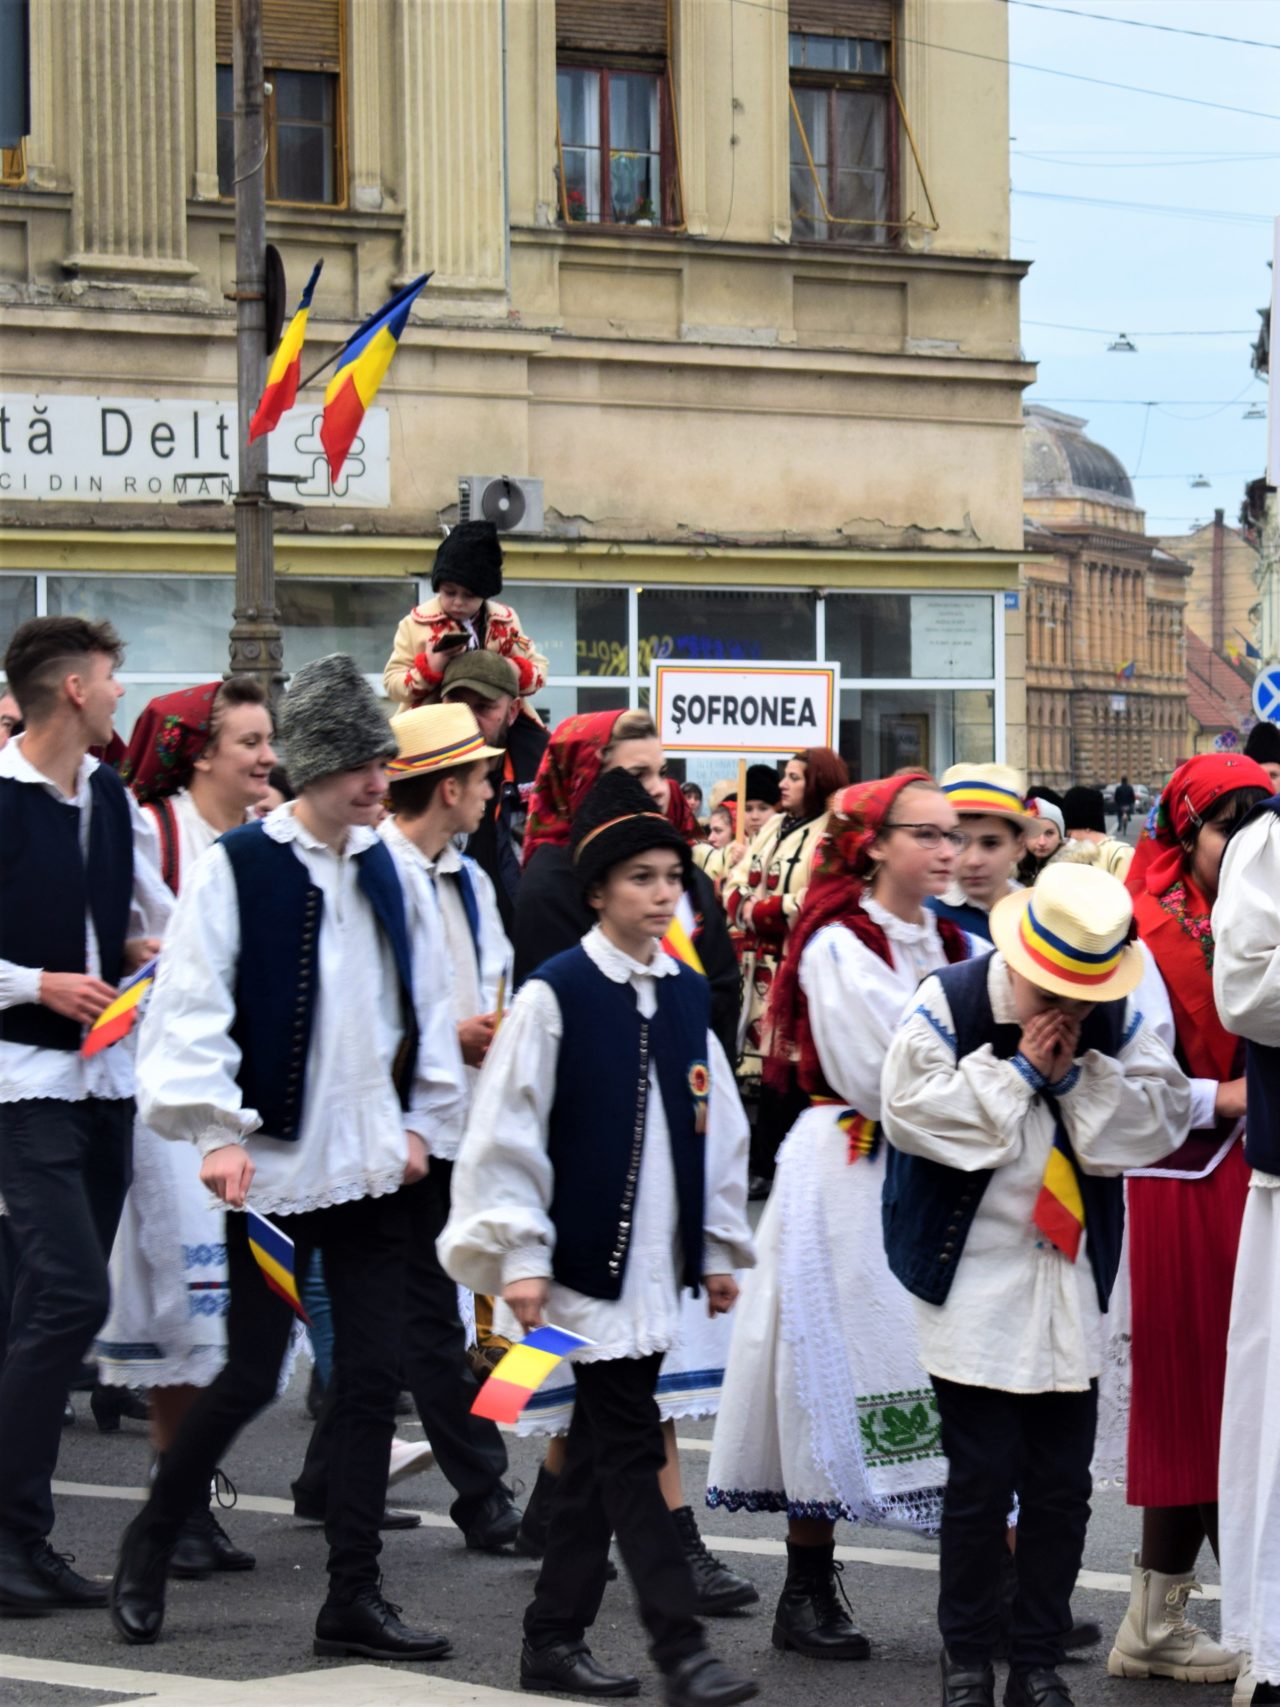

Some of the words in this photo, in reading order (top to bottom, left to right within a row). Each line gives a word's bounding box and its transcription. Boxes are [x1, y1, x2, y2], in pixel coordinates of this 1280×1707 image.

[102, 408, 230, 459] Delt
[50, 475, 102, 492] DIN
[124, 476, 233, 494] ROMAN
